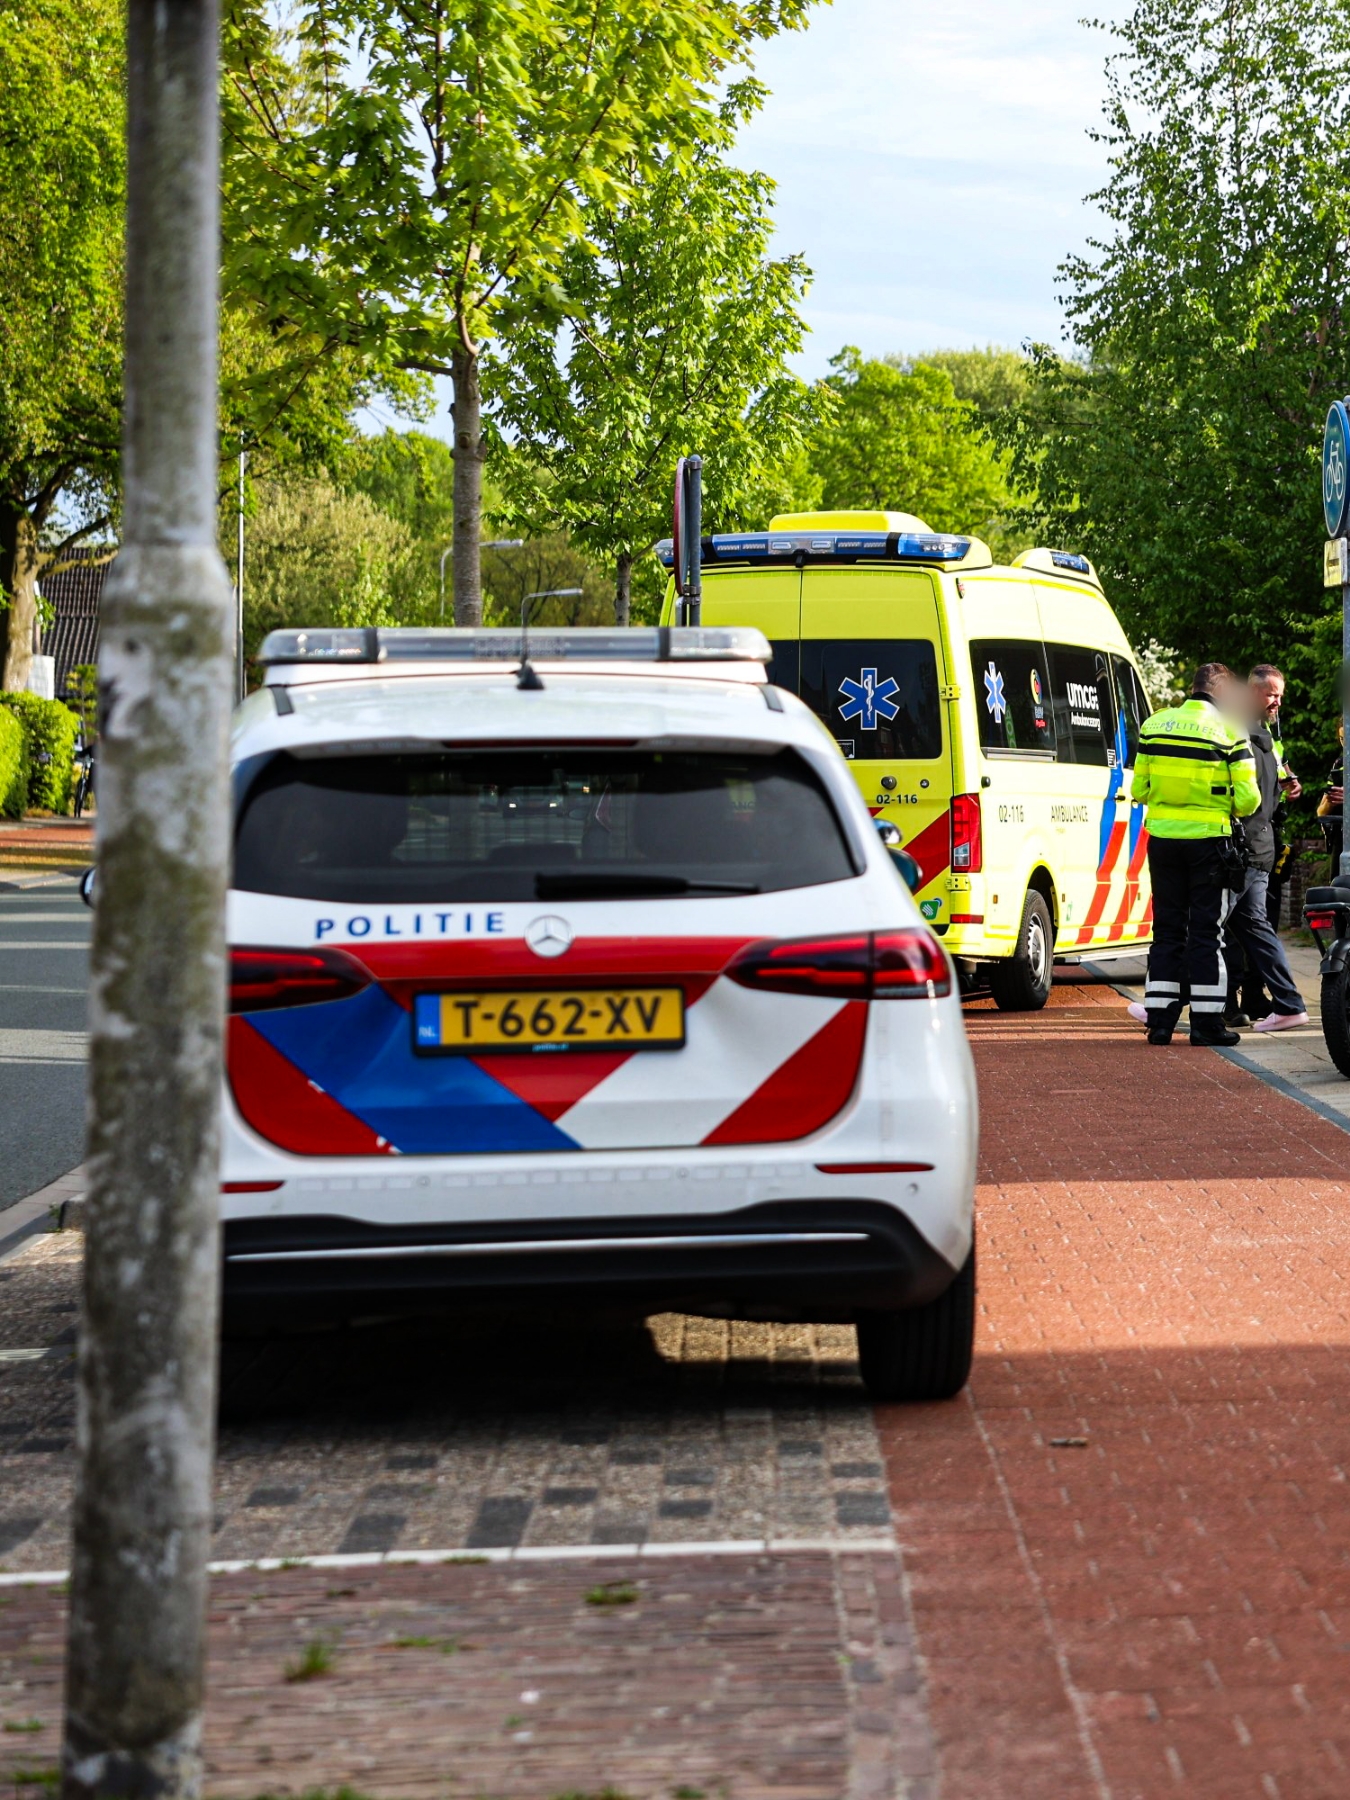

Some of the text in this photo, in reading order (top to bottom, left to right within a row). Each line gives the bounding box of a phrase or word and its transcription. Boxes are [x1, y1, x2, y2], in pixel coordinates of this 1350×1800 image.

[1160, 718, 1208, 733] POLITIE
[876, 794, 918, 804] 02-116
[998, 805, 1025, 823] 02-116
[1051, 805, 1089, 822] AMBULANCE
[315, 911, 506, 940] POLITIE
[453, 996, 662, 1038] T-662-XV
